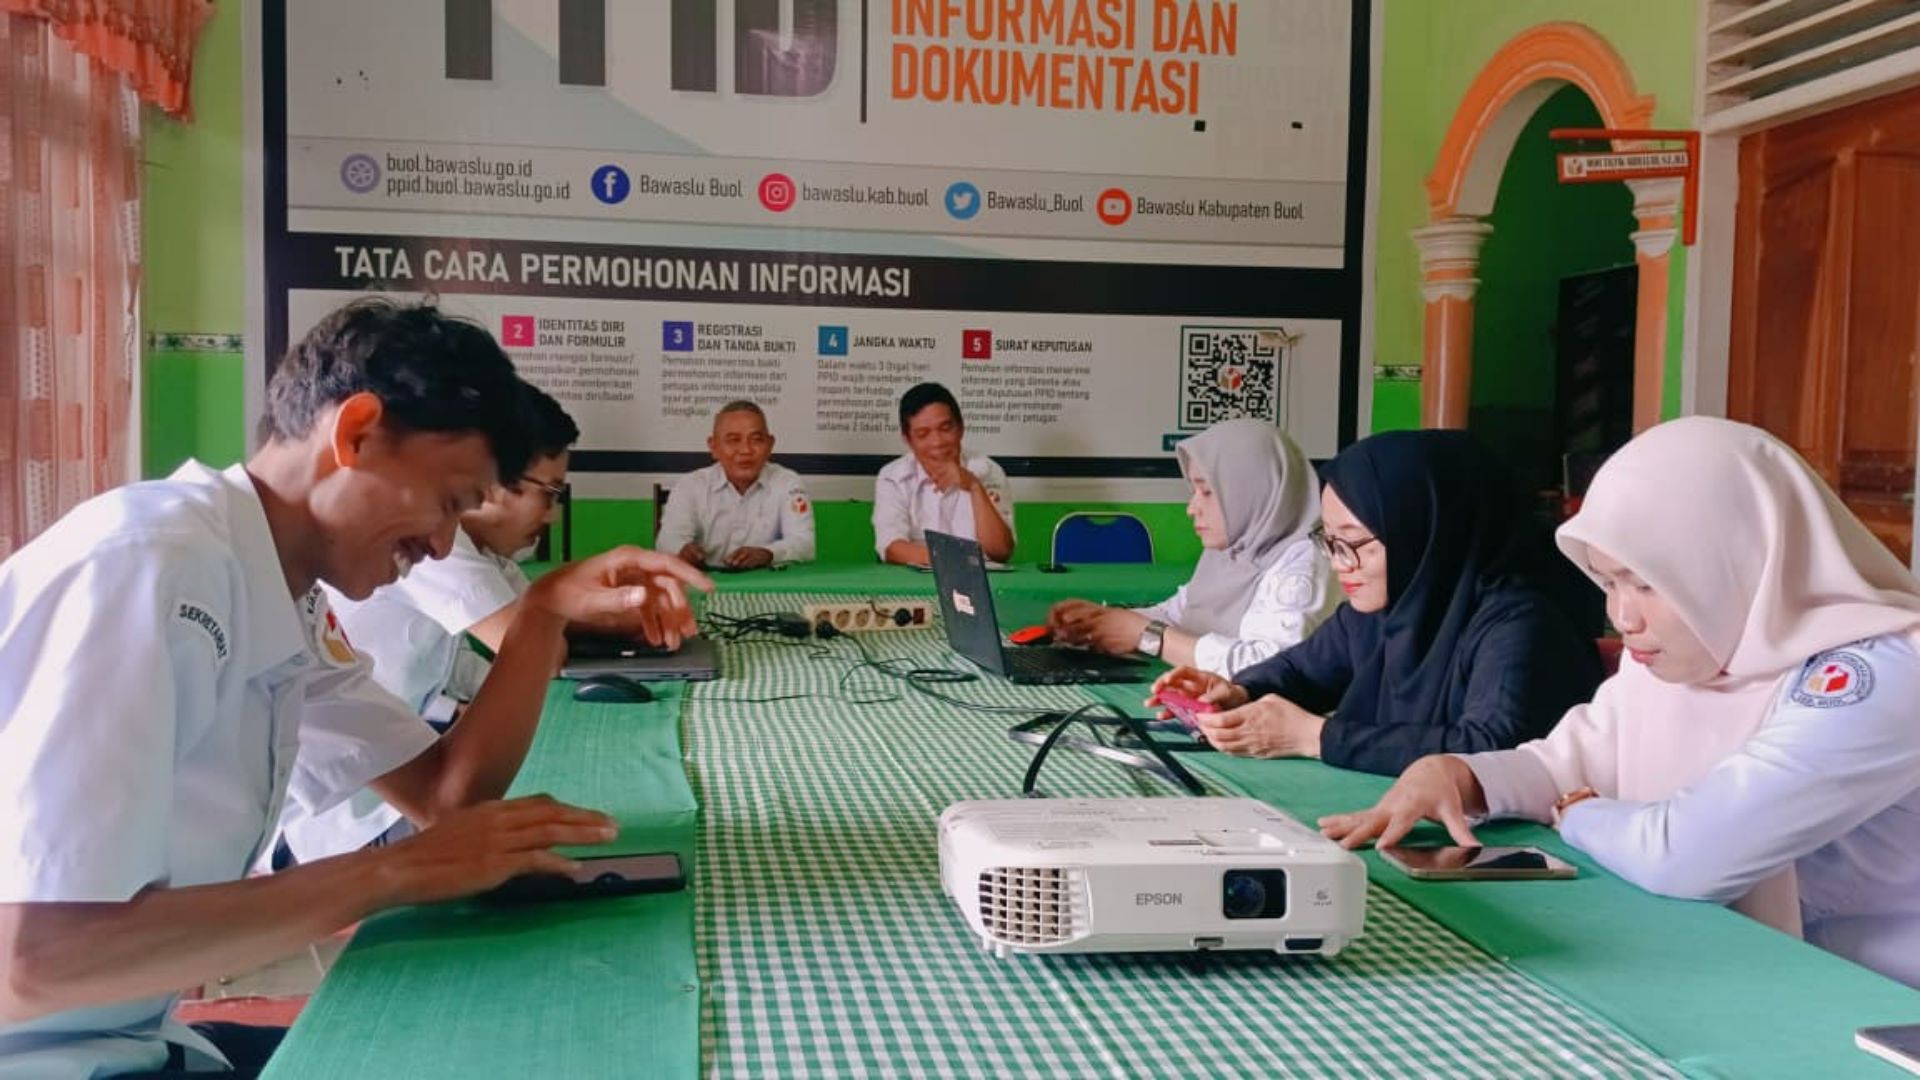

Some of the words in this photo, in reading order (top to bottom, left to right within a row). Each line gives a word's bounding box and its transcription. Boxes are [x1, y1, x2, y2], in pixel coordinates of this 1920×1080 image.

[891, 0, 1134, 51] INFORMASI
[1152, 0, 1238, 56] DAN
[890, 43, 1200, 116] DOKUMENTASI
[387, 154, 533, 179] buol.bawaslu.go.id
[387, 174, 571, 202] ppid.buol.bawaslu.go.id
[640, 174, 705, 198] Bawaslu
[709, 178, 744, 199] Buol
[802, 182, 929, 207] bawaslu.kab.buol
[987, 190, 1084, 214] Bawaslu_Buol
[1137, 196, 1194, 218] Bawaslu
[1198, 198, 1269, 221] Kabupaten
[1273, 200, 1304, 220] Buol
[335, 246, 414, 280] TATA
[423, 248, 510, 283] CARA
[521, 252, 741, 291] PERMOHONAN
[749, 262, 911, 299] INFORMASI
[513, 323, 523, 339] 2
[539, 319, 598, 332] IDENTITAS
[601, 320, 625, 332] DIRI
[697, 324, 763, 337] REGISTRASI
[539, 334, 563, 346] DAN
[566, 334, 626, 347] FORMULIR
[673, 328, 683, 344] 3
[829, 333, 838, 348] 4
[853, 336, 896, 348] JANGKA
[898, 337, 936, 349] WAKTU
[697, 339, 721, 351] DAN
[724, 339, 762, 352] TANDA
[764, 340, 796, 352] BUKTI
[972, 337, 982, 352] 5
[995, 339, 1029, 352] SURAT
[1031, 340, 1093, 353] KEPUTUSAN
[1135, 892, 1183, 907] EPSON
